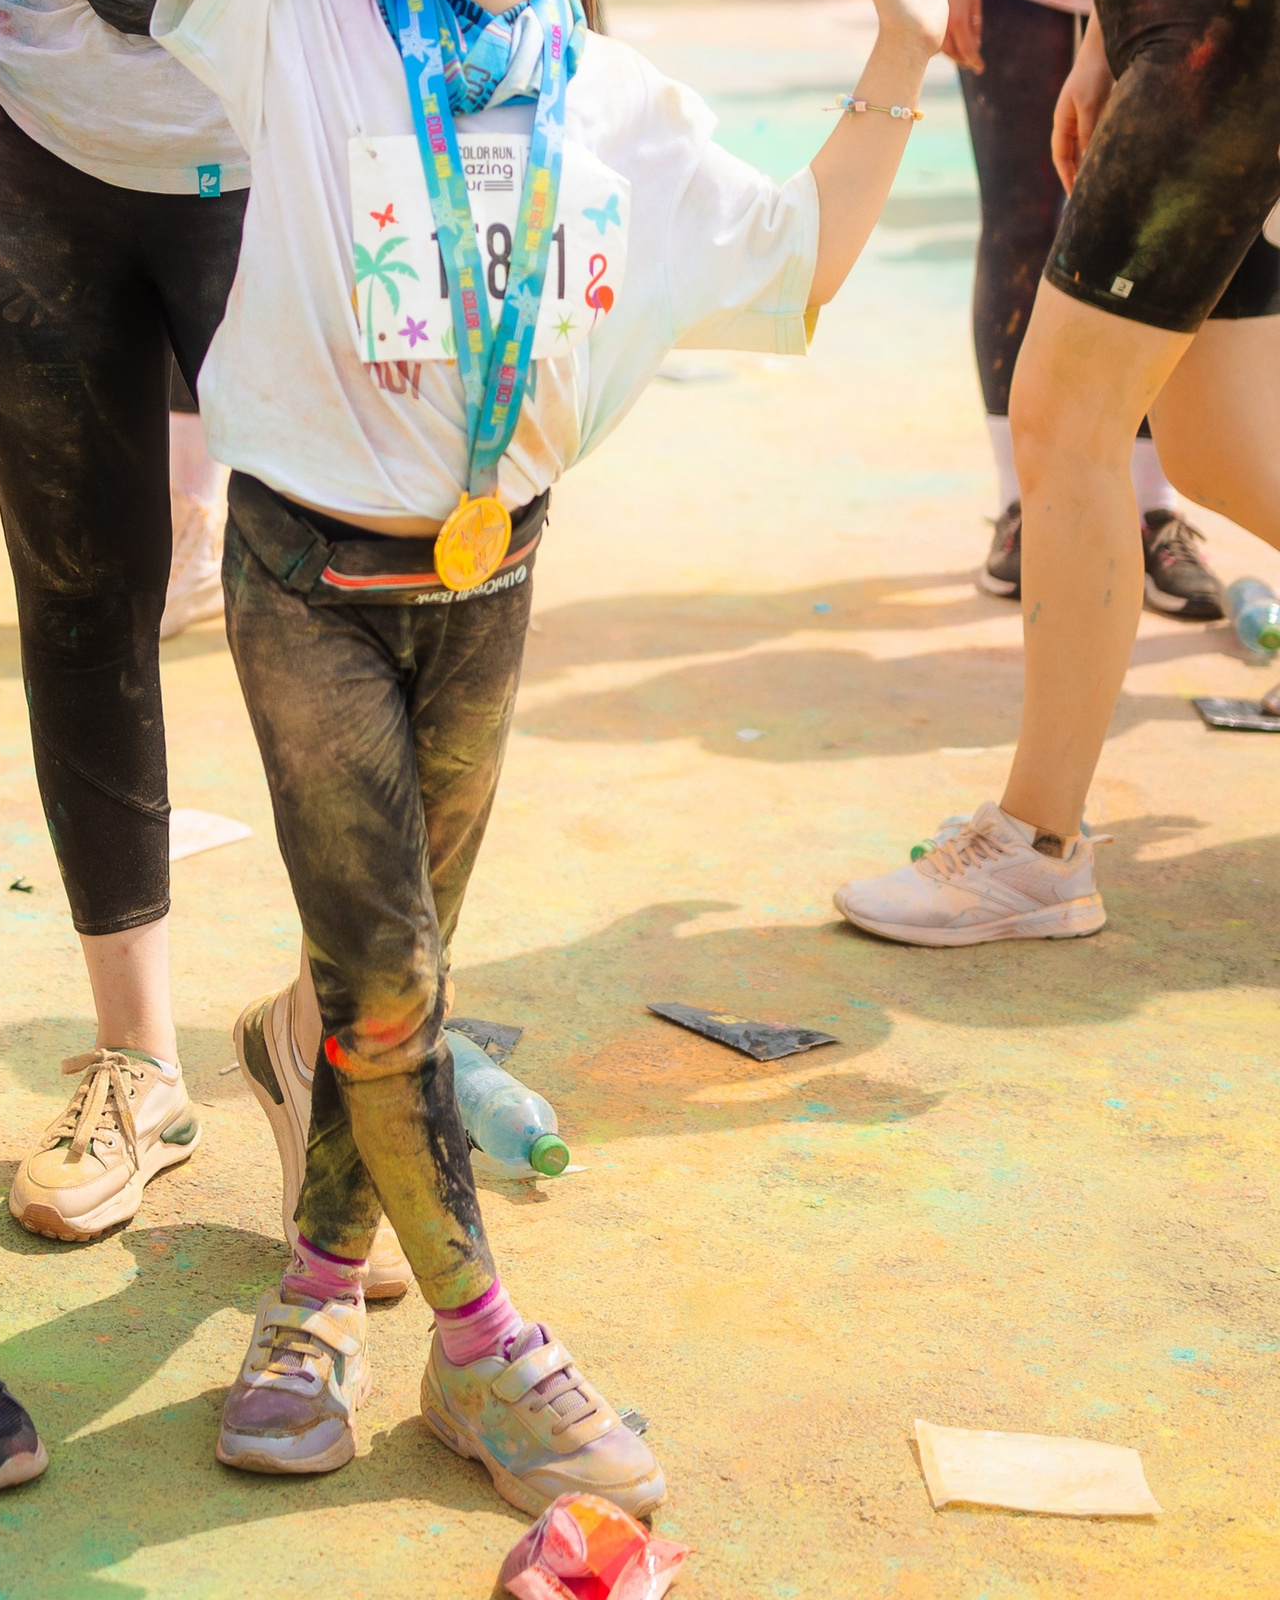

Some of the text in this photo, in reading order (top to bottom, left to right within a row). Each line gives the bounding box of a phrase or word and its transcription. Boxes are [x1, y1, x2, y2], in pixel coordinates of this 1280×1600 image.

[550, 24, 563, 60] COLOR
[426, 115, 447, 154] COLOR
[465, 161, 514, 180] azing
[461, 290, 481, 329] COLOR
[496, 365, 516, 404] COLOR
